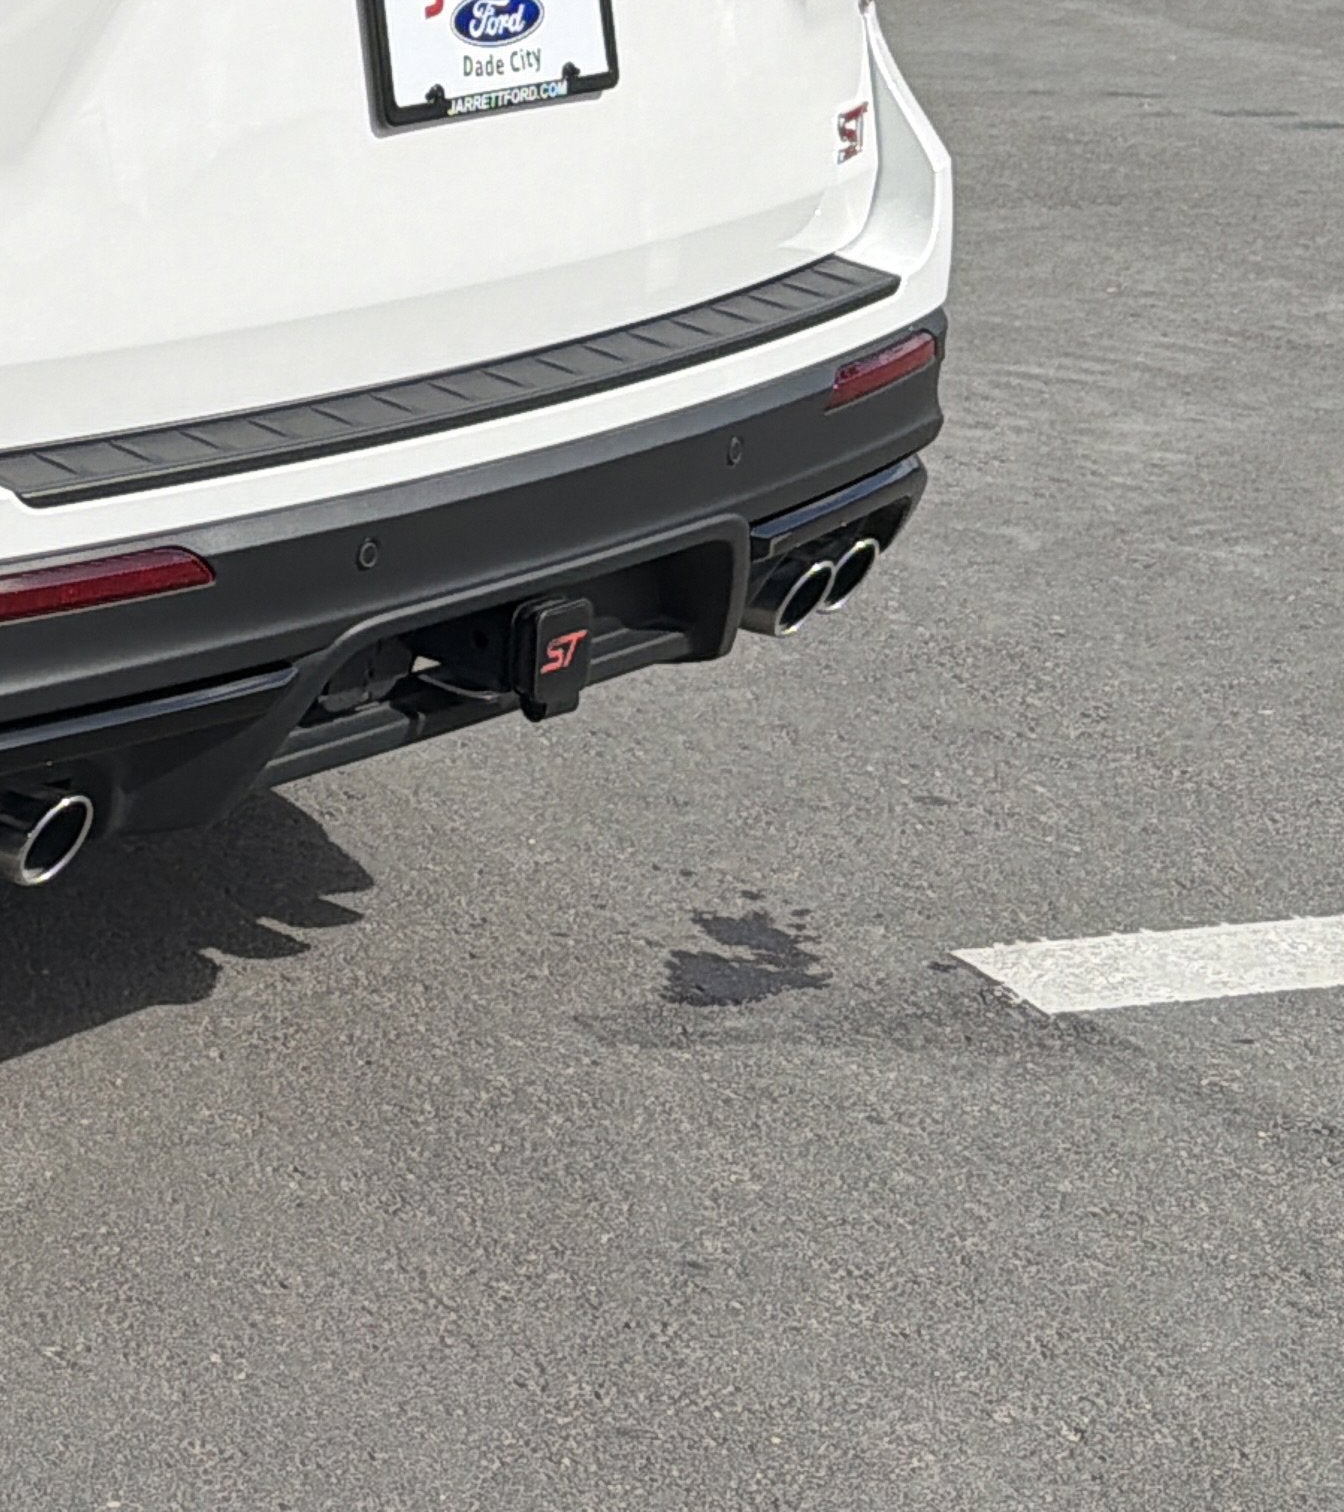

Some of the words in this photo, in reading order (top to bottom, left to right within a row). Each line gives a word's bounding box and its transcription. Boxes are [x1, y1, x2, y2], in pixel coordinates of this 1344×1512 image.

[463, 54, 505, 76] Dade
[511, 48, 542, 72] City
[447, 79, 568, 116] JARRETTFORD.COM
[837, 101, 869, 165] ST
[540, 629, 588, 674] ST
